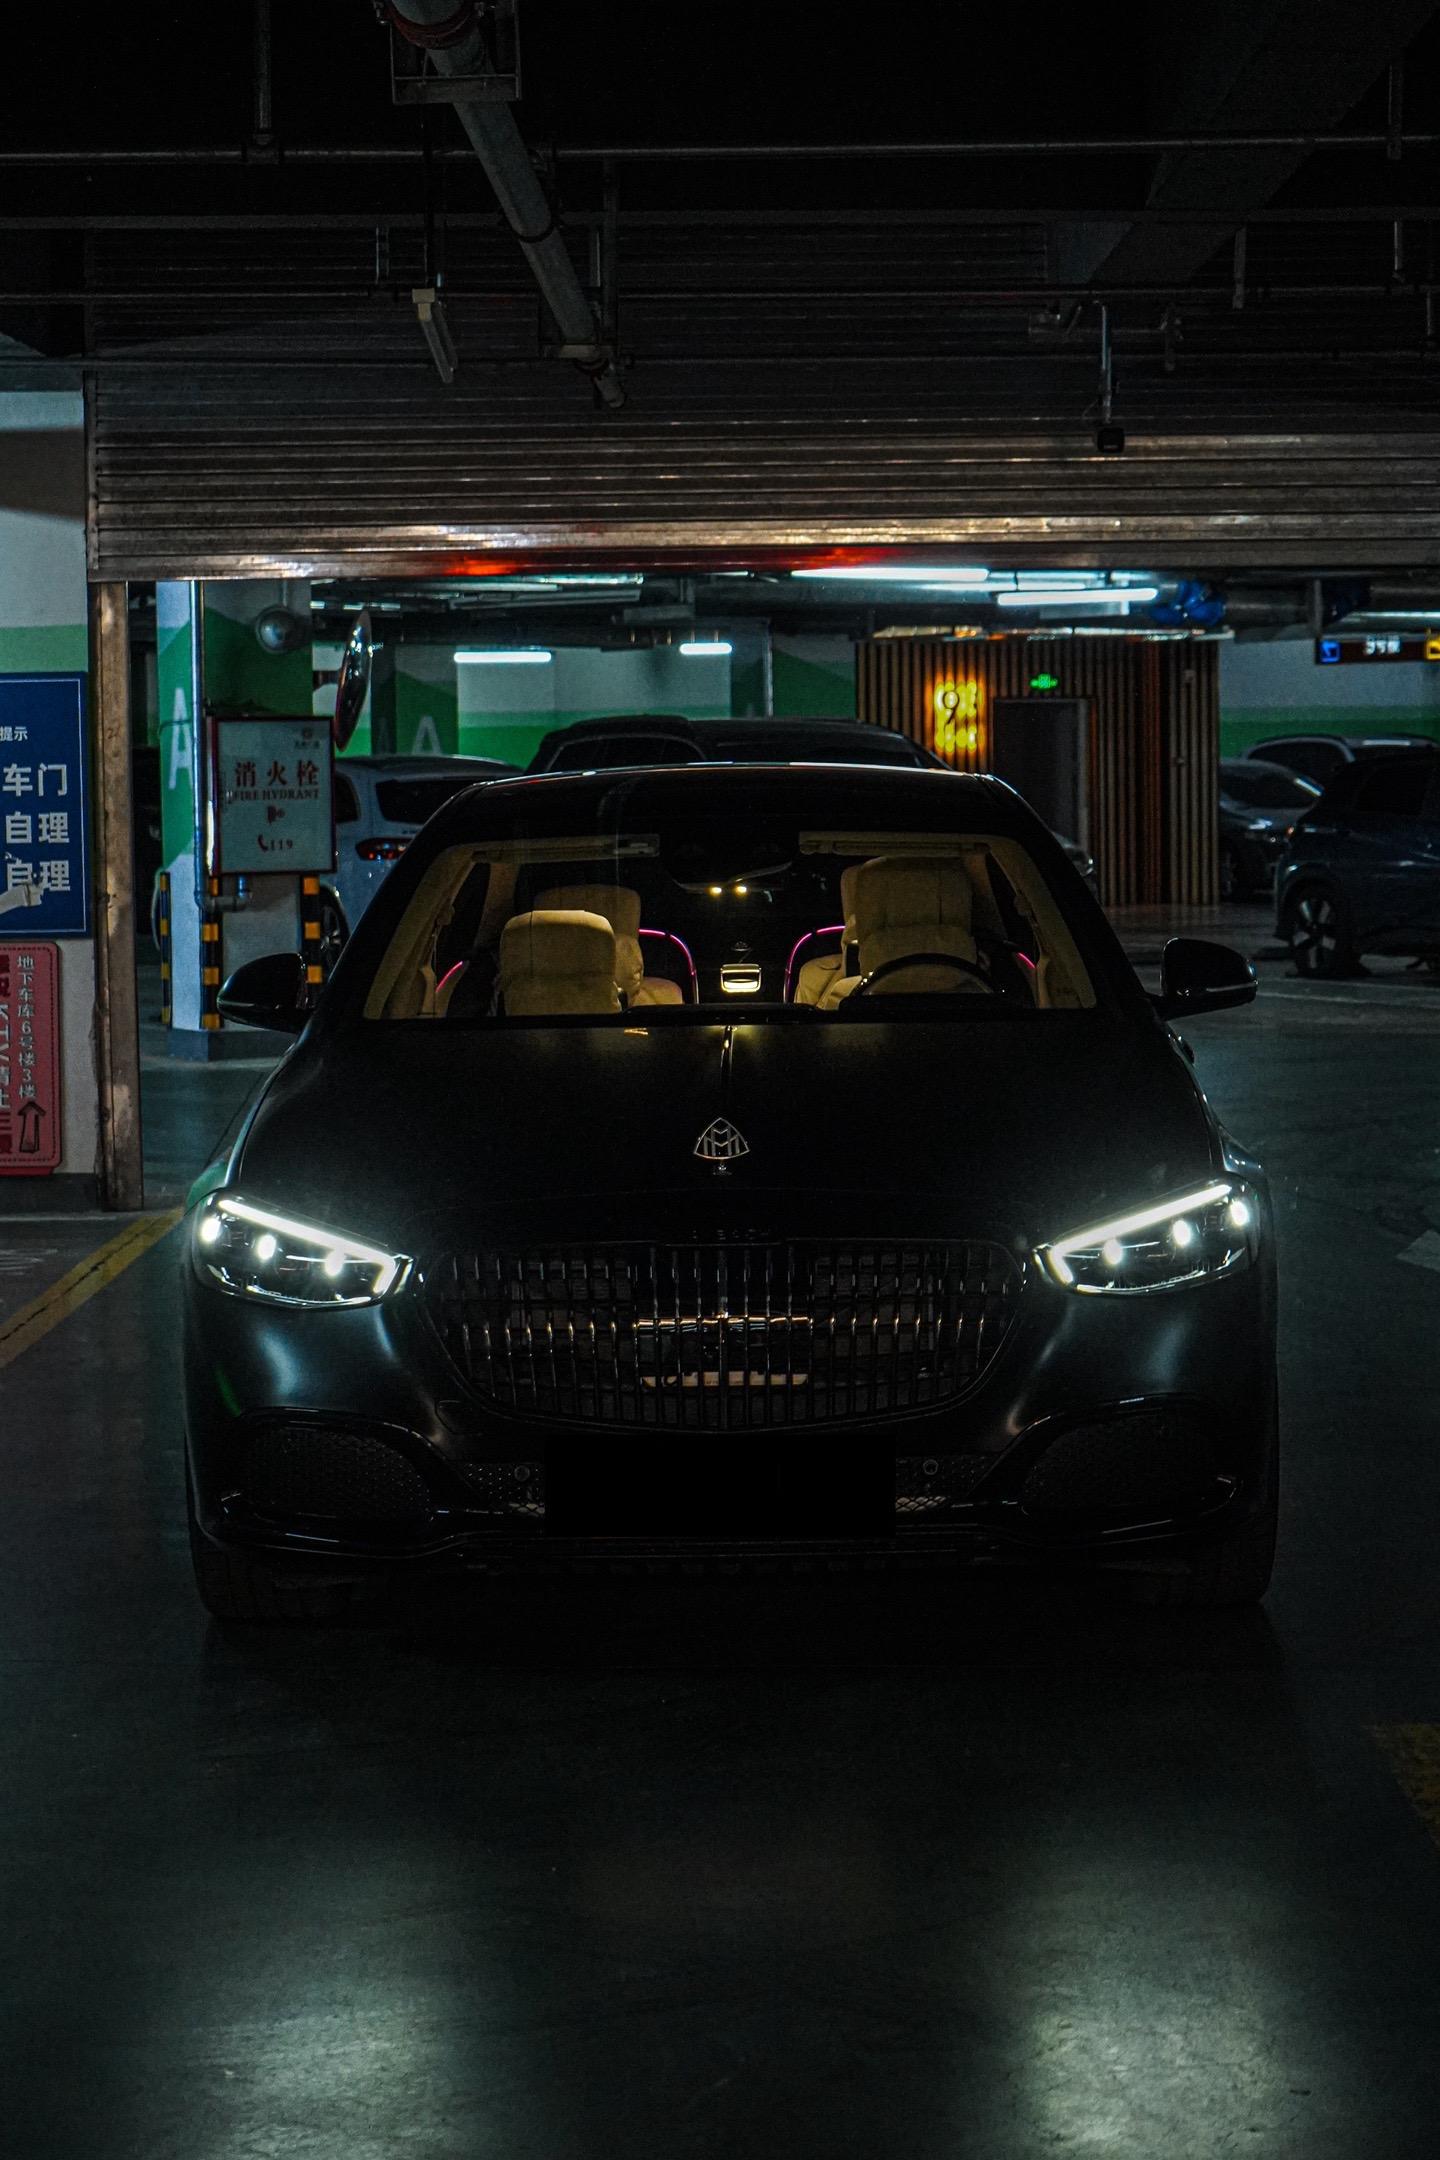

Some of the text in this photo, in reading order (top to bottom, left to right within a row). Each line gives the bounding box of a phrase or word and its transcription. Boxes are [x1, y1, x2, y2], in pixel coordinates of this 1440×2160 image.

[168, 687, 193, 791] A
[411, 716, 442, 755] A
[2, 763, 67, 796] 车门
[236, 760, 319, 787] 消火栓
[262, 789, 319, 800] HYDRANT
[5, 811, 70, 843] 自理
[270, 839, 293, 850] 119
[6, 857, 70, 891] 自理
